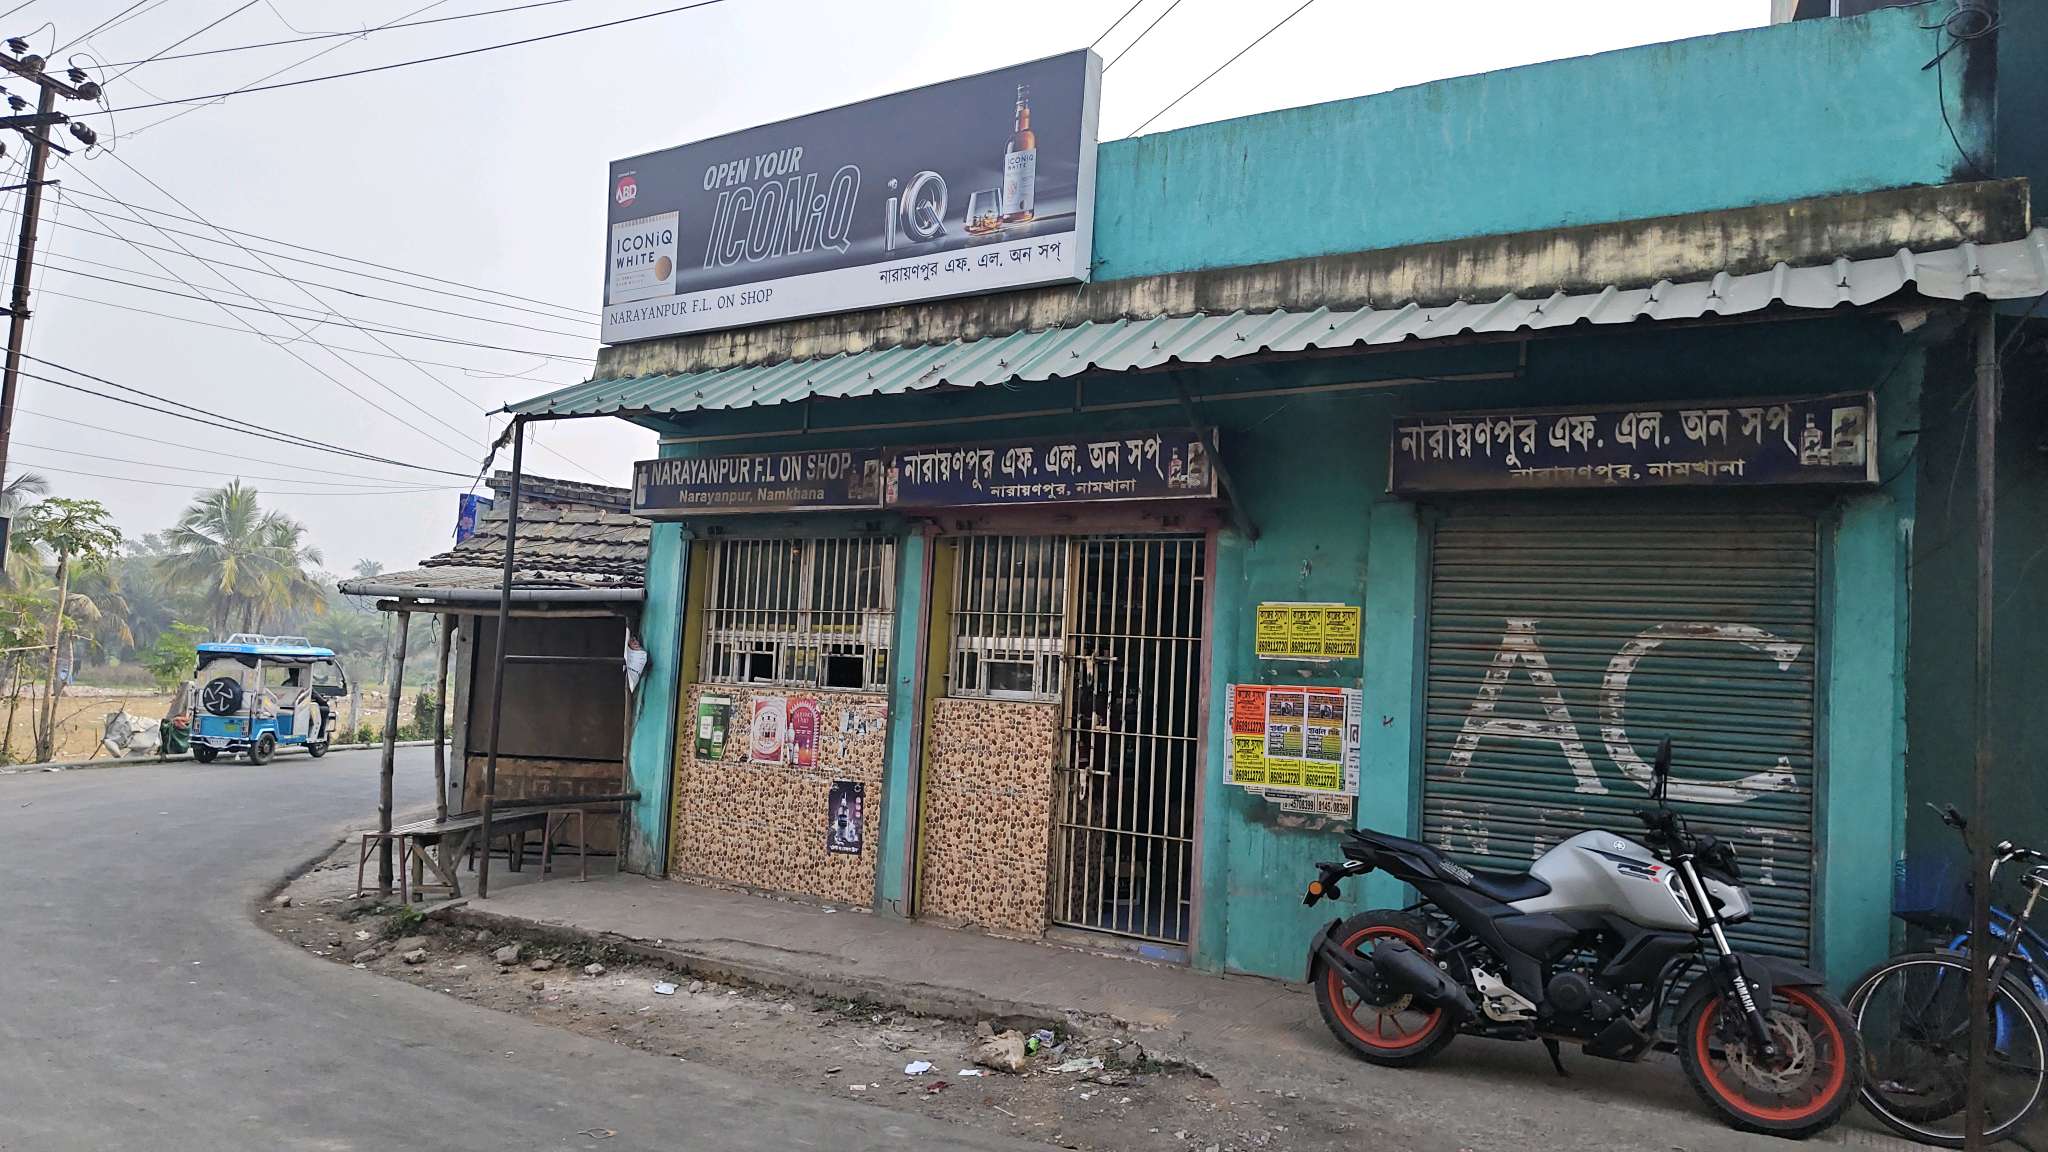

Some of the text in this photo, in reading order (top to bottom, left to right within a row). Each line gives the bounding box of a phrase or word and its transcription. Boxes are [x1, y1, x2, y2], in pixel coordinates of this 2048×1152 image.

[703, 147, 803, 190] OPEN YOUR
[616, 252, 655, 269] WHITE
[879, 261, 938, 283] নারায়ণপুর
[944, 256, 971, 274] এফ.
[977, 252, 1003, 267] এল.
[1009, 246, 1031, 263] অন
[609, 288, 773, 326] NARAYANPUR F.L. ON SHOP
[1399, 416, 1538, 468] নারায়ণপুর
[1549, 415, 1604, 453] এফ.
[1615, 411, 1671, 450] এল.
[1679, 408, 1731, 447] অন
[650, 458, 750, 486] NARAYANPUR
[779, 456, 802, 482] ON
[806, 453, 851, 480] SHOP
[904, 447, 995, 491] নারায়ণপুর
[1001, 447, 1038, 479] এফ.
[1045, 444, 1082, 477] এল.
[1088, 439, 1121, 476] অন
[1646, 459, 1746, 478] নামখানা
[757, 486, 825, 501] Namkhana
[1075, 478, 1136, 495] নামখানা
[1446, 618, 1803, 803] AC
[1733, 975, 1757, 1013] YAMAHA
